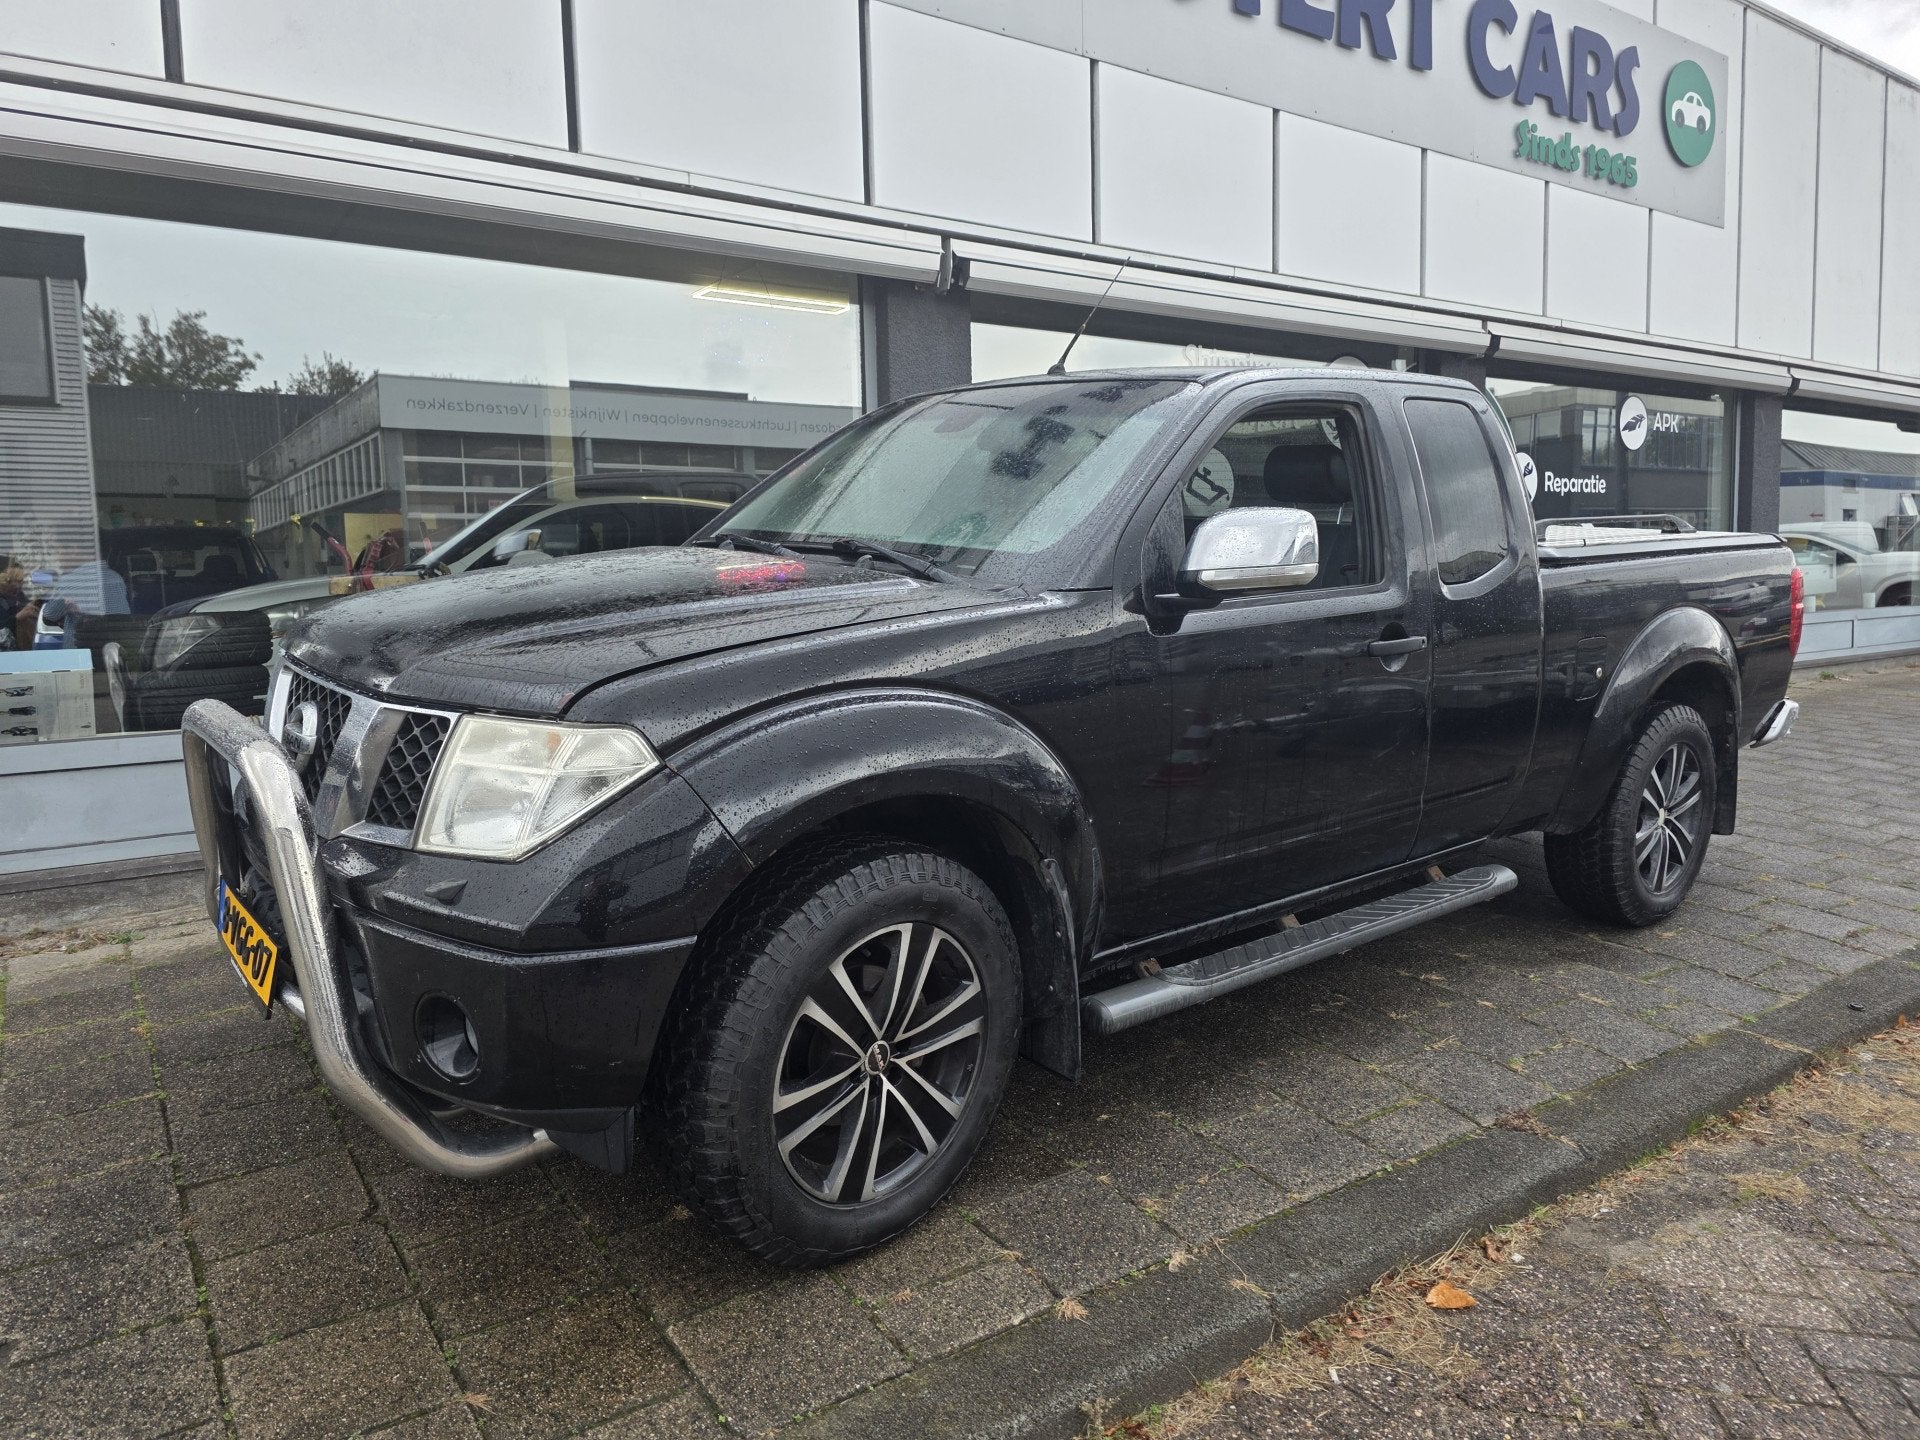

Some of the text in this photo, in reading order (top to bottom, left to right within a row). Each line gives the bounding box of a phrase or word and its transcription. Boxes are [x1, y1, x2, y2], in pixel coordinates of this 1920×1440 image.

[1468, 0, 1640, 138] CARS
[1516, 119, 1638, 188] Sinds 1965
[1652, 411, 1680, 433] APK
[1543, 471, 1607, 497] Reparatie
